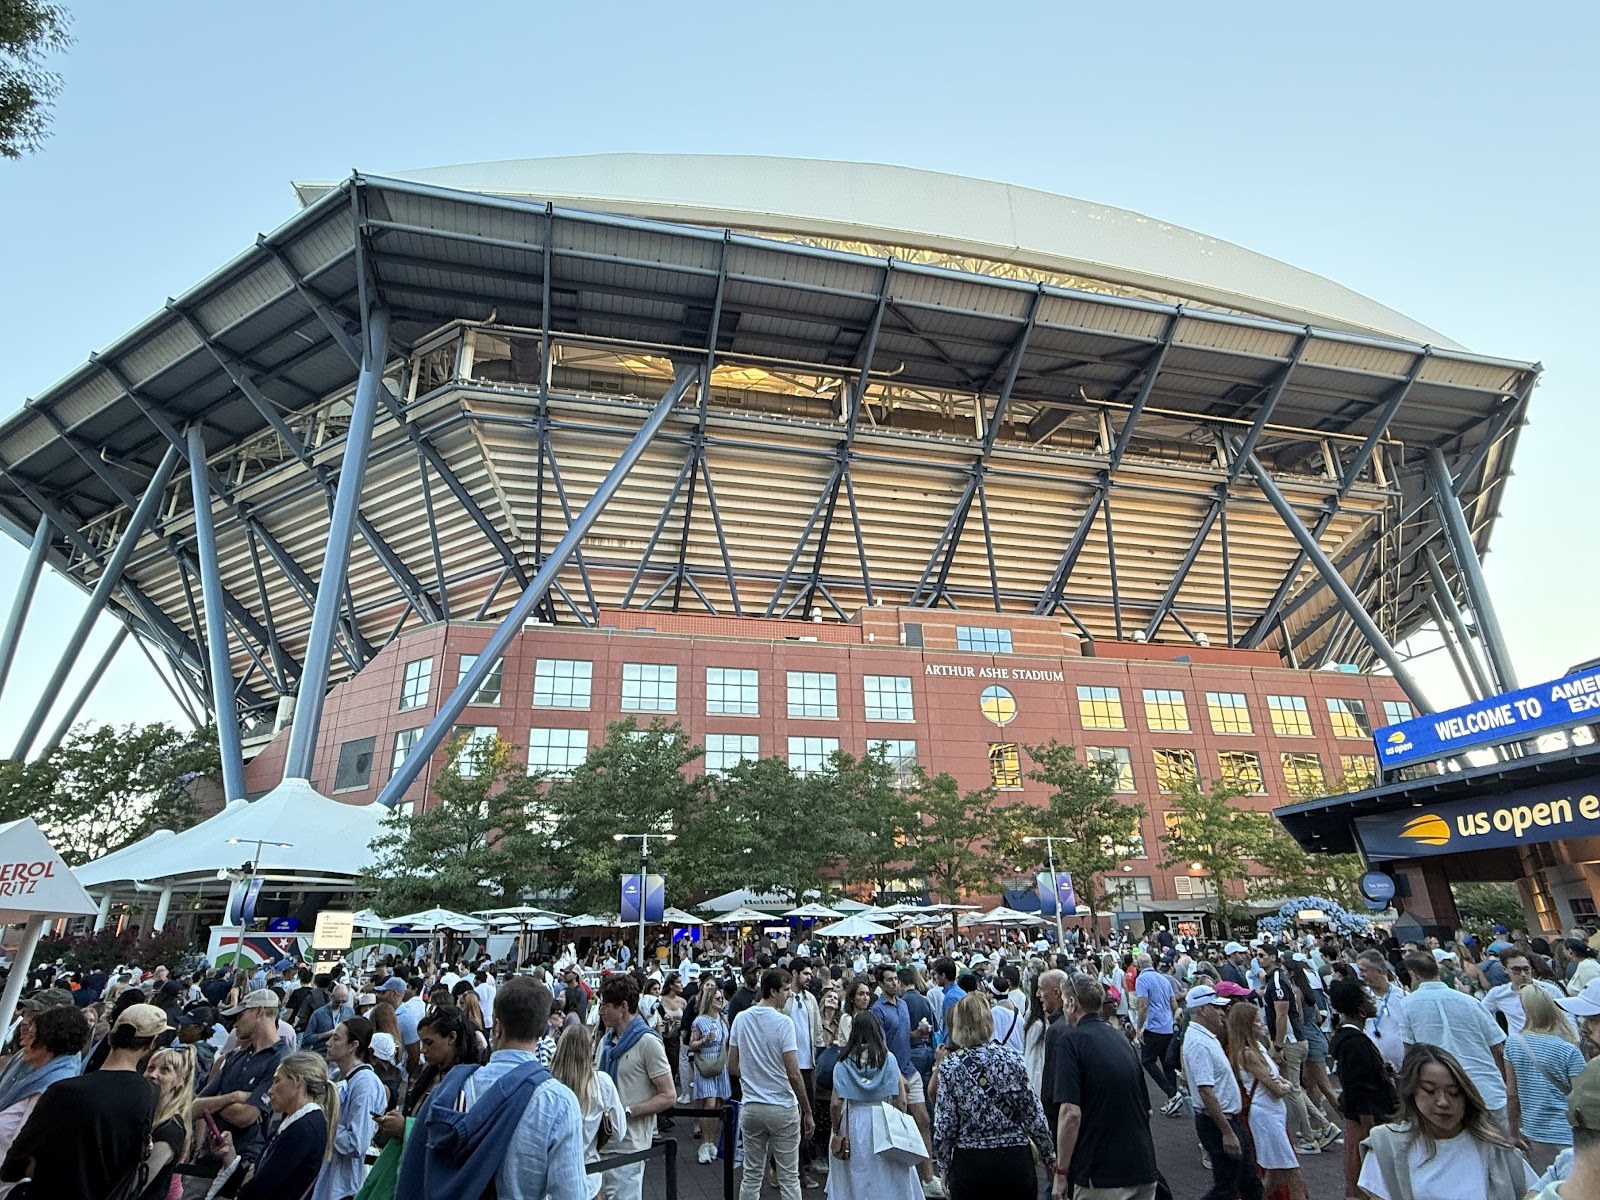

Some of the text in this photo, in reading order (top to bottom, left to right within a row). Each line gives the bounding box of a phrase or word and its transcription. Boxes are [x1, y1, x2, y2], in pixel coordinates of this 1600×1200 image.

[925, 664, 1064, 682] ARTHUR ASHE STADIUM
[1434, 697, 1542, 741] WELCOME TO
[1385, 742, 1413, 756] us open
[1456, 811, 1491, 837] us
[1493, 798, 1573, 838] open
[0, 861, 55, 882] EROL
